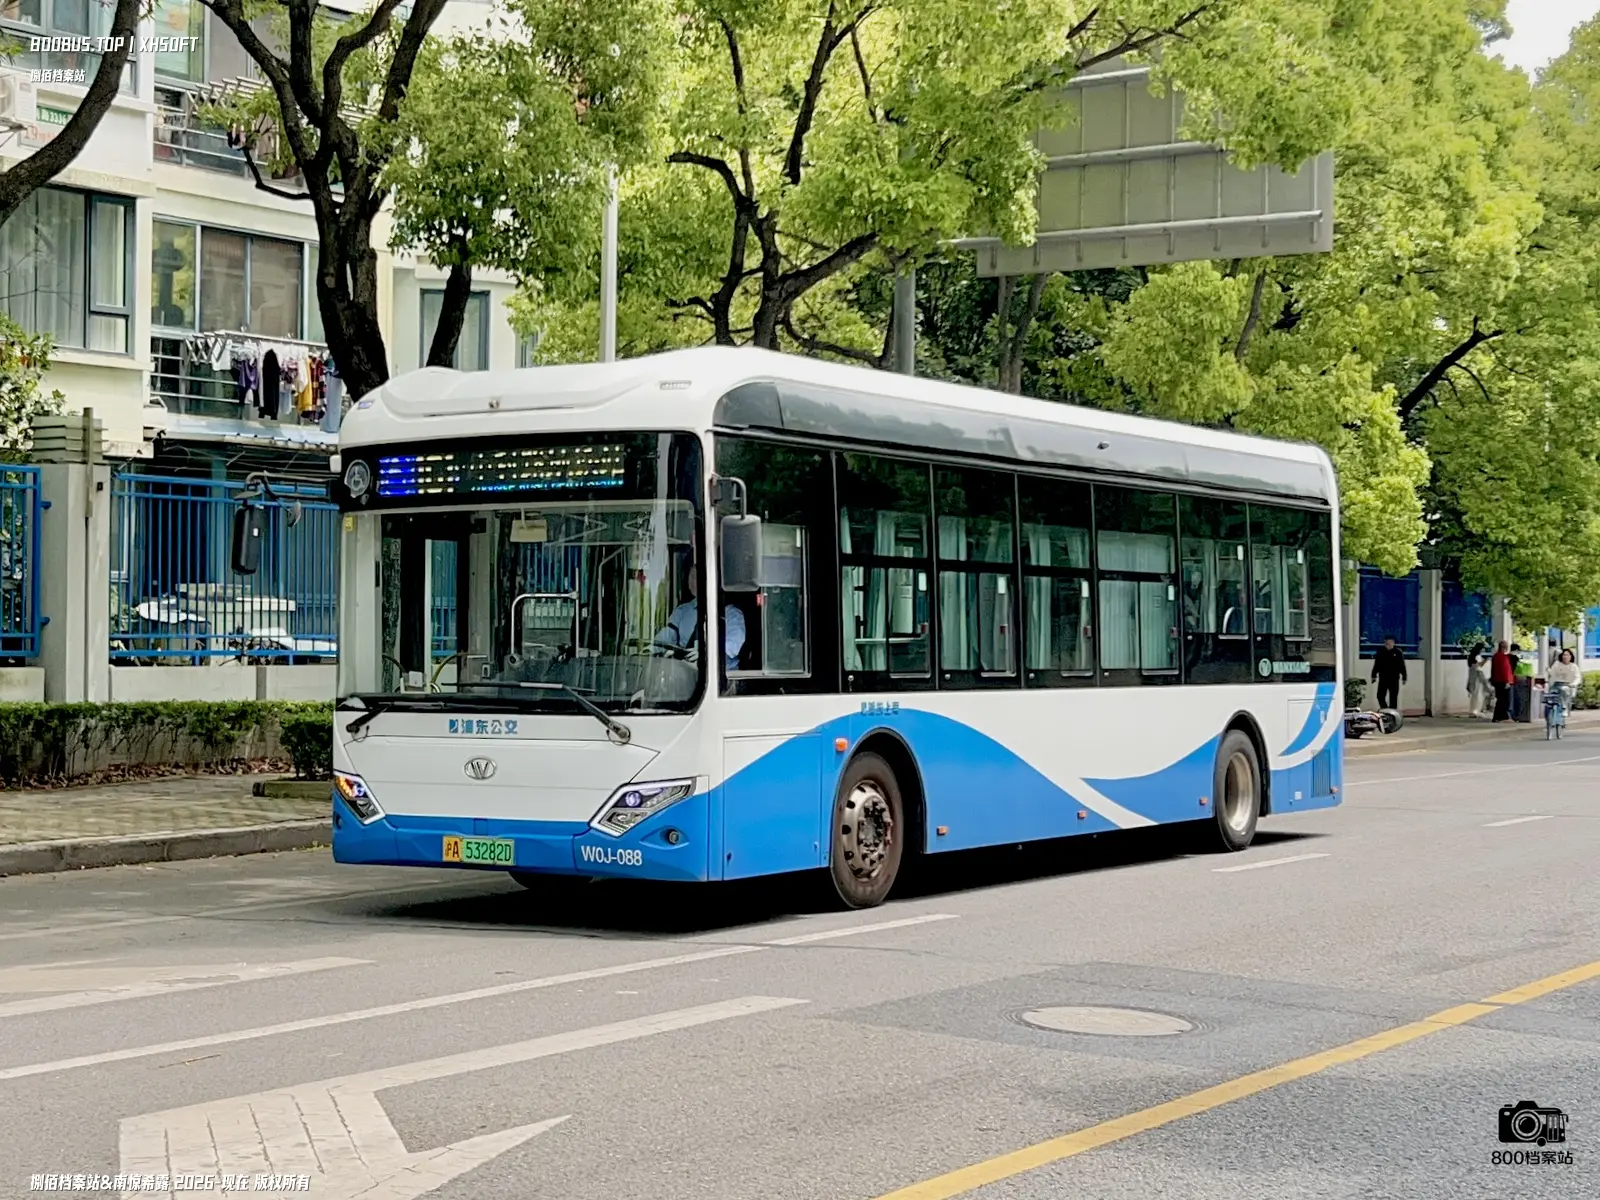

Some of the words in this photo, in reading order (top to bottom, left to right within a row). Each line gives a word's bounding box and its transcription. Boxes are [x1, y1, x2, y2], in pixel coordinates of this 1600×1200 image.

[461, 719, 518, 734] 浦东公交
[465, 841, 512, 862] 53282D
